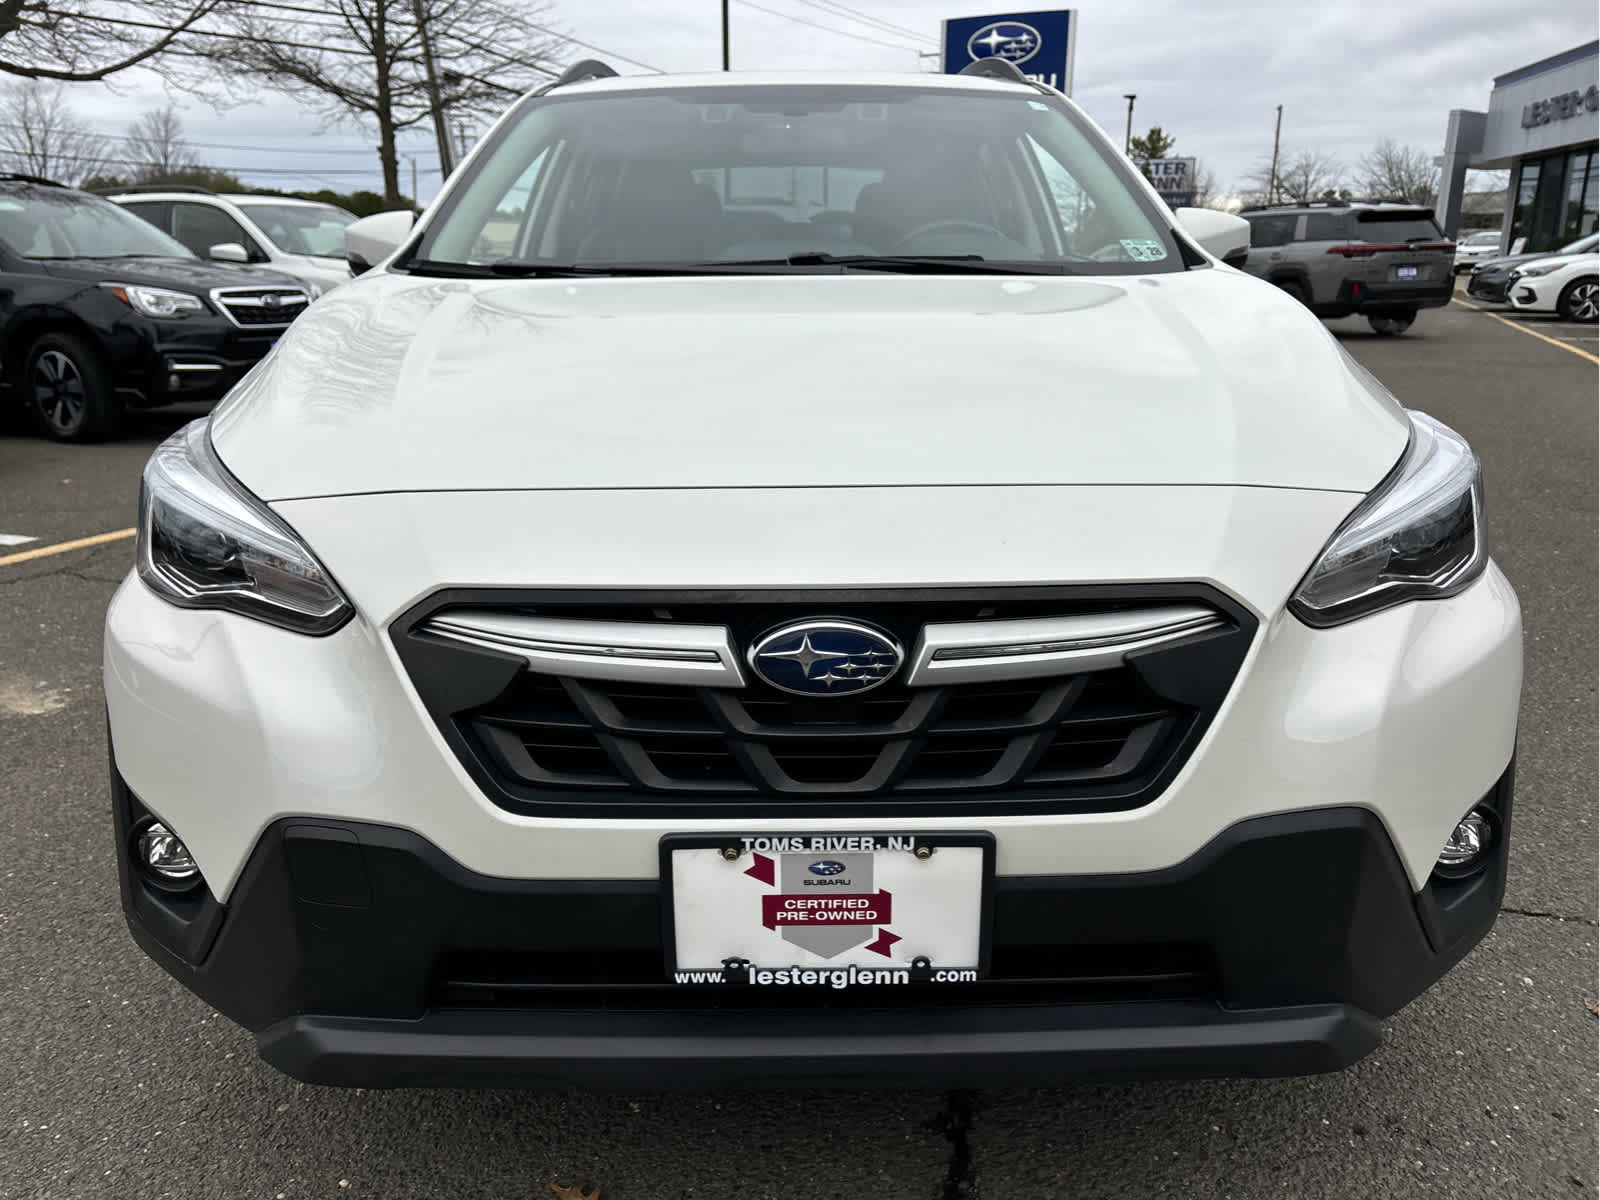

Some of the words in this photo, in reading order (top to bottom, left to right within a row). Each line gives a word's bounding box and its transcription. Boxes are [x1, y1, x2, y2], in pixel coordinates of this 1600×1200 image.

[741, 837, 804, 852] TOMS
[888, 836, 915, 851] NJ
[784, 899, 870, 909] CERTIFIED
[776, 910, 878, 921] PRE-OWNED
[674, 972, 727, 984] www.
[748, 966, 909, 989] lesterglenn
[930, 970, 977, 982] .com
